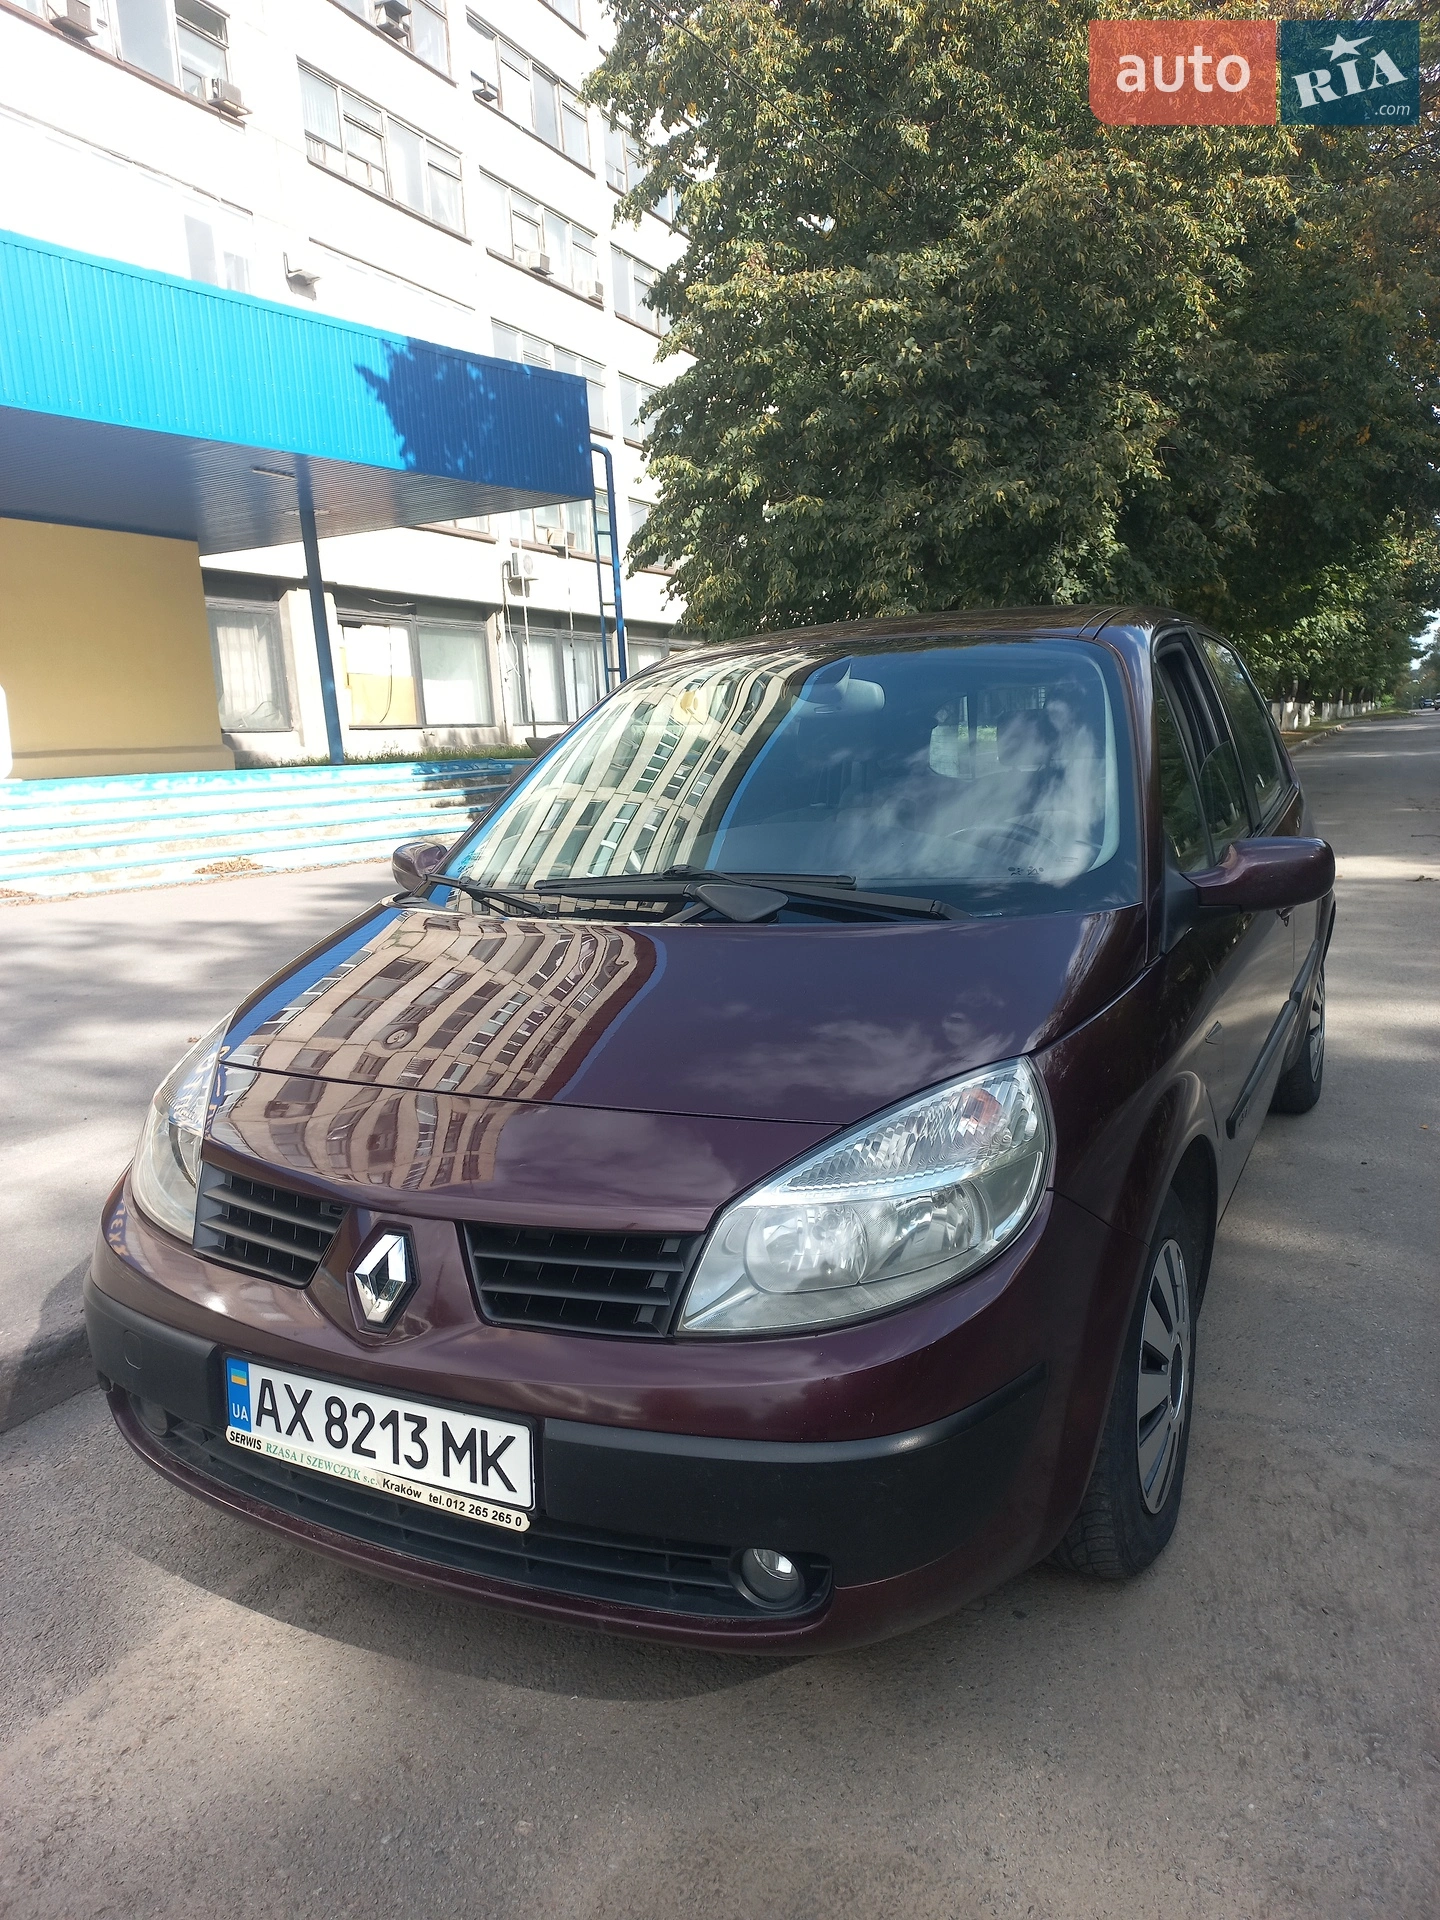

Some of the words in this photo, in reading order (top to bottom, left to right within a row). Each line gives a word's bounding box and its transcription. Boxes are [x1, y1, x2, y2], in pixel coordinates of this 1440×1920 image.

[232, 1403, 248, 1422] UA
[256, 1378, 314, 1442] AX
[324, 1396, 429, 1470] 8213
[442, 1421, 517, 1493] MK
[230, 1430, 262, 1450] SERWIS
[301, 1453, 305, 1463] I
[307, 1456, 361, 1480] SZEWCZYK
[363, 1476, 379, 1487] s.c.
[382, 1478, 422, 1499] Kraków
[469, 1504, 488, 1518] 265
[492, 1510, 512, 1524] 265
[515, 1516, 522, 1527] 0
